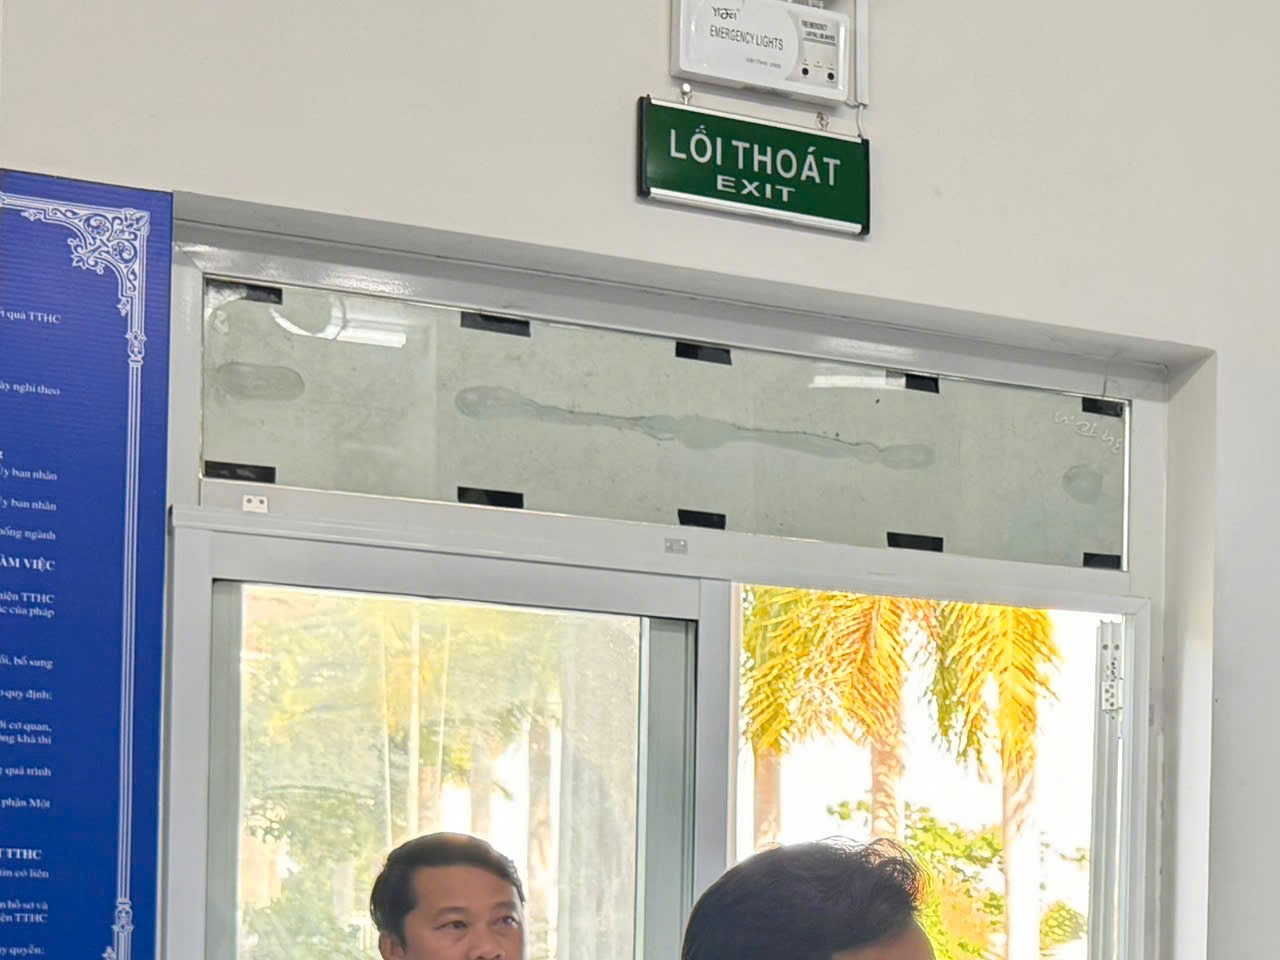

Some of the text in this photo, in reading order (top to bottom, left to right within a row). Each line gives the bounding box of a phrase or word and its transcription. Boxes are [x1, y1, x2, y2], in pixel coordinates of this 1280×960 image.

[710, 25, 755, 45] EMERGENCY
[755, 33, 784, 51] LIGHTS
[670, 124, 840, 186] LỐI THOÁT
[717, 175, 796, 202] EXIT
[27, 311, 61, 324] TTHC
[37, 384, 60, 396] theo
[12, 467, 31, 479] ban
[32, 469, 58, 481] nhân
[11, 498, 30, 509] ban
[32, 500, 57, 511] nhân
[25, 529, 56, 541] ngành
[23, 556, 56, 572] VIỆC
[20, 592, 55, 604] TTHC
[29, 607, 55, 619] pháp
[29, 659, 54, 671] sung
[38, 735, 52, 745] thi
[14, 912, 48, 923] TTHC
